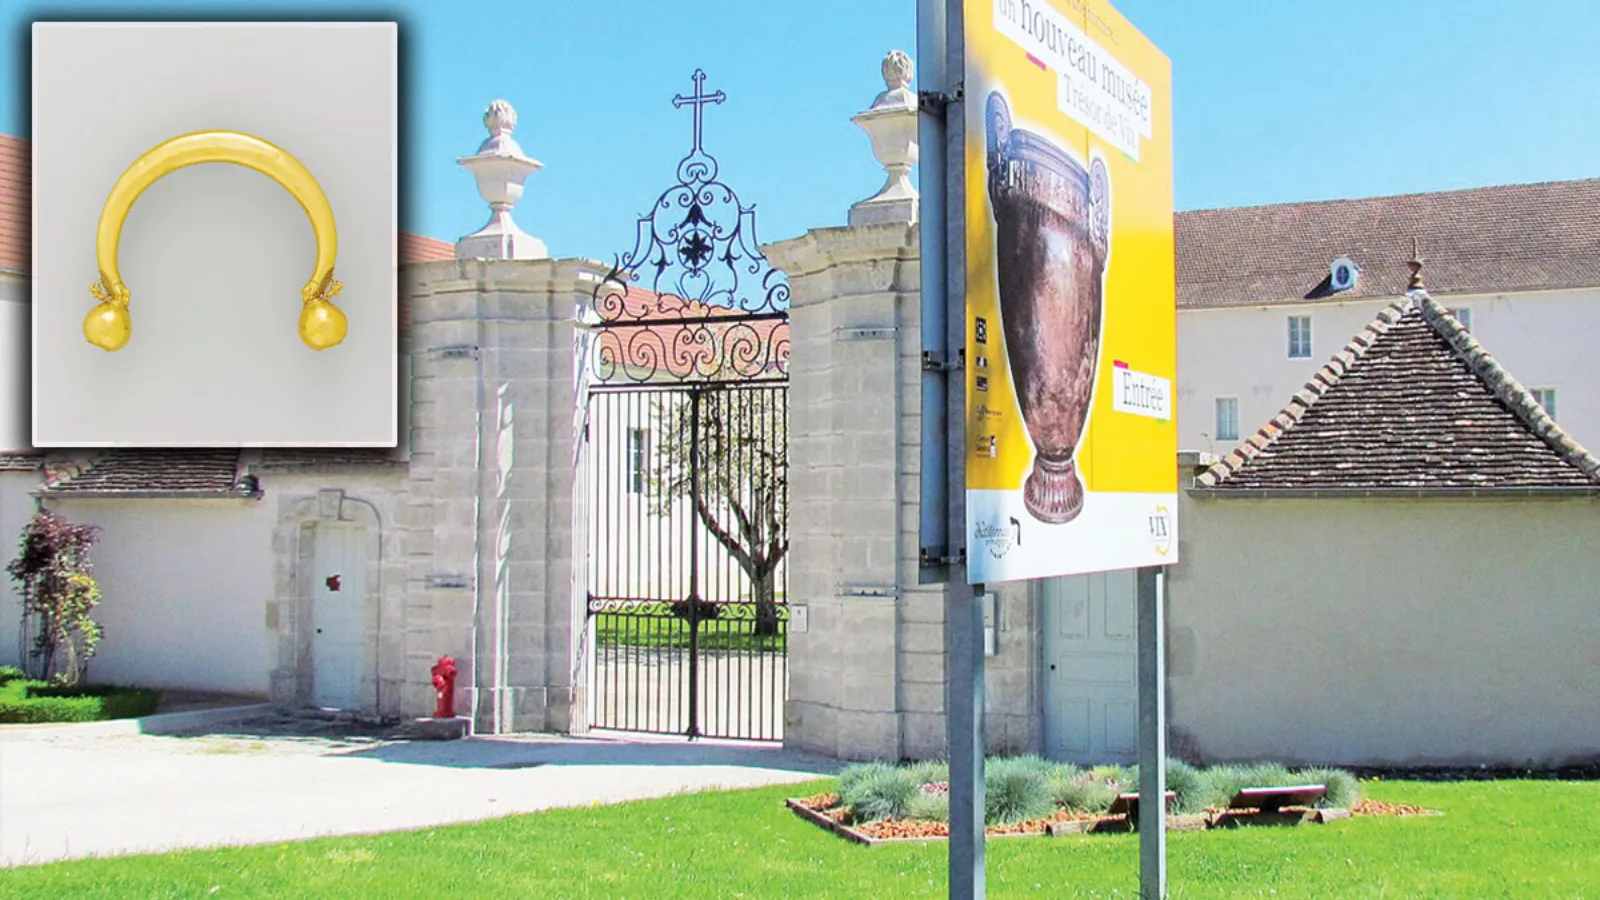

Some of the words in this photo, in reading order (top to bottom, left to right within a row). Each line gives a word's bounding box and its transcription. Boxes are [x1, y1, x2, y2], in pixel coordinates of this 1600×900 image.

[1020, 0, 1097, 83] nouveau
[1101, 64, 1148, 121] musée
[1063, 73, 1103, 124] Trésor
[1104, 102, 1118, 136] de
[1123, 372, 1163, 411] Entrée
